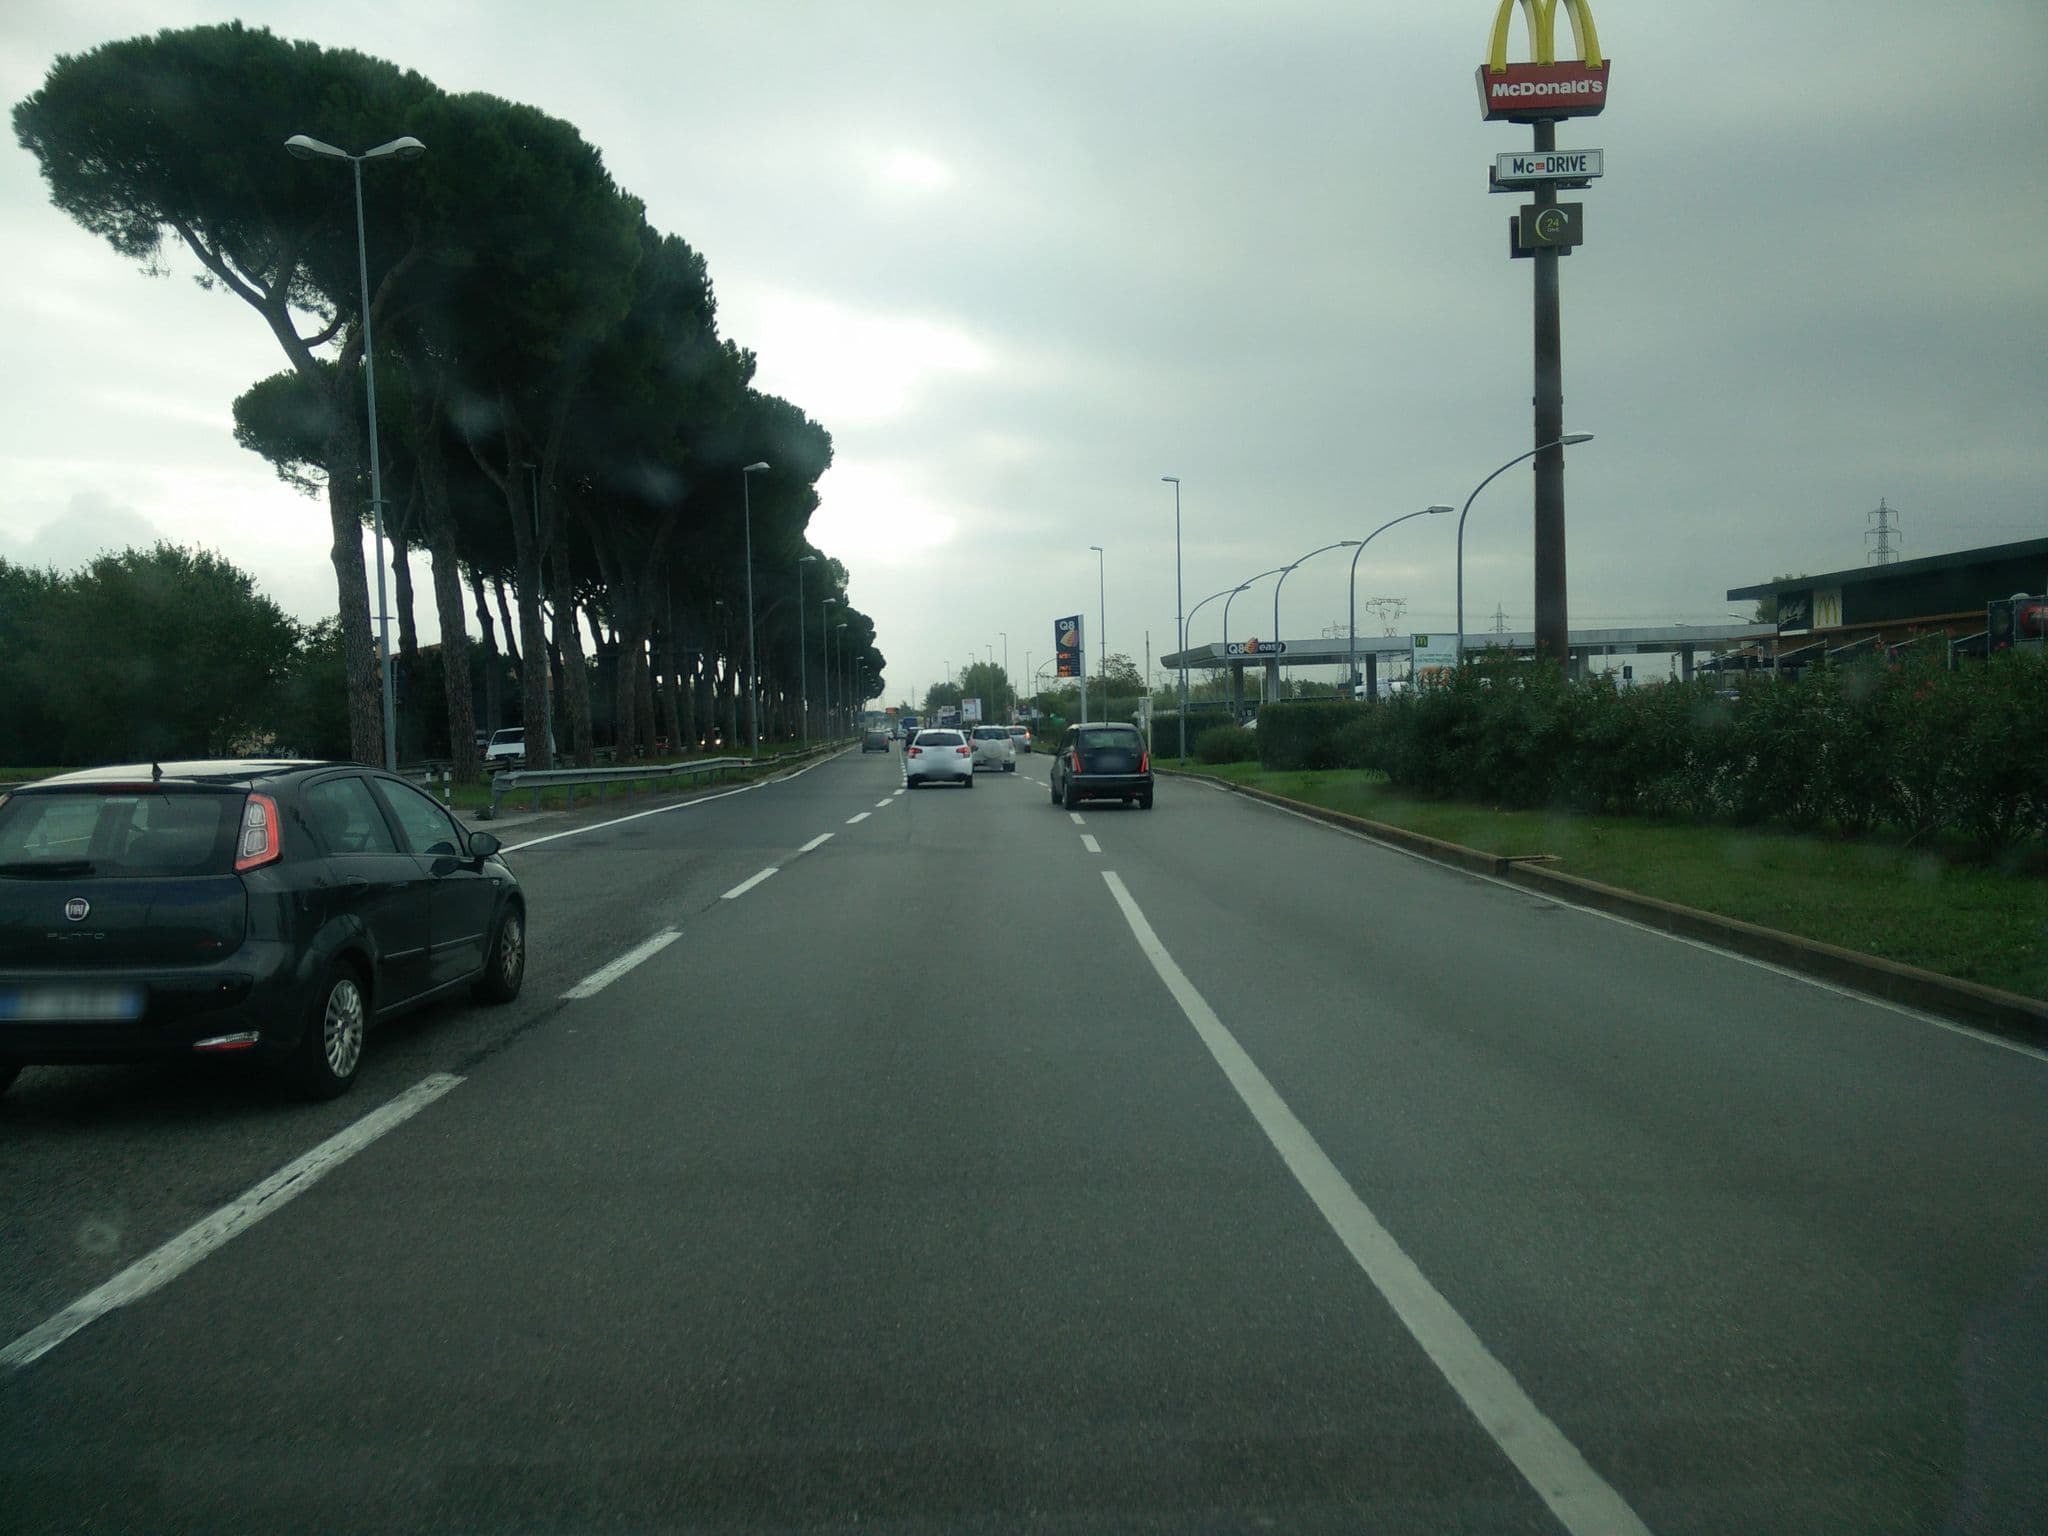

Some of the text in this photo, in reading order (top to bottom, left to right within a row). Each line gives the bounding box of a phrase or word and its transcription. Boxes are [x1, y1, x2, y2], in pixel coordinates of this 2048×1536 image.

[1491, 79, 1604, 97] McDonald's
[1545, 154, 1588, 174] DRIVE
[1546, 217, 1560, 229] 24
[1059, 620, 1076, 631] Q8
[1228, 643, 1245, 654] Q8
[70, 904, 85, 916] FIAT
